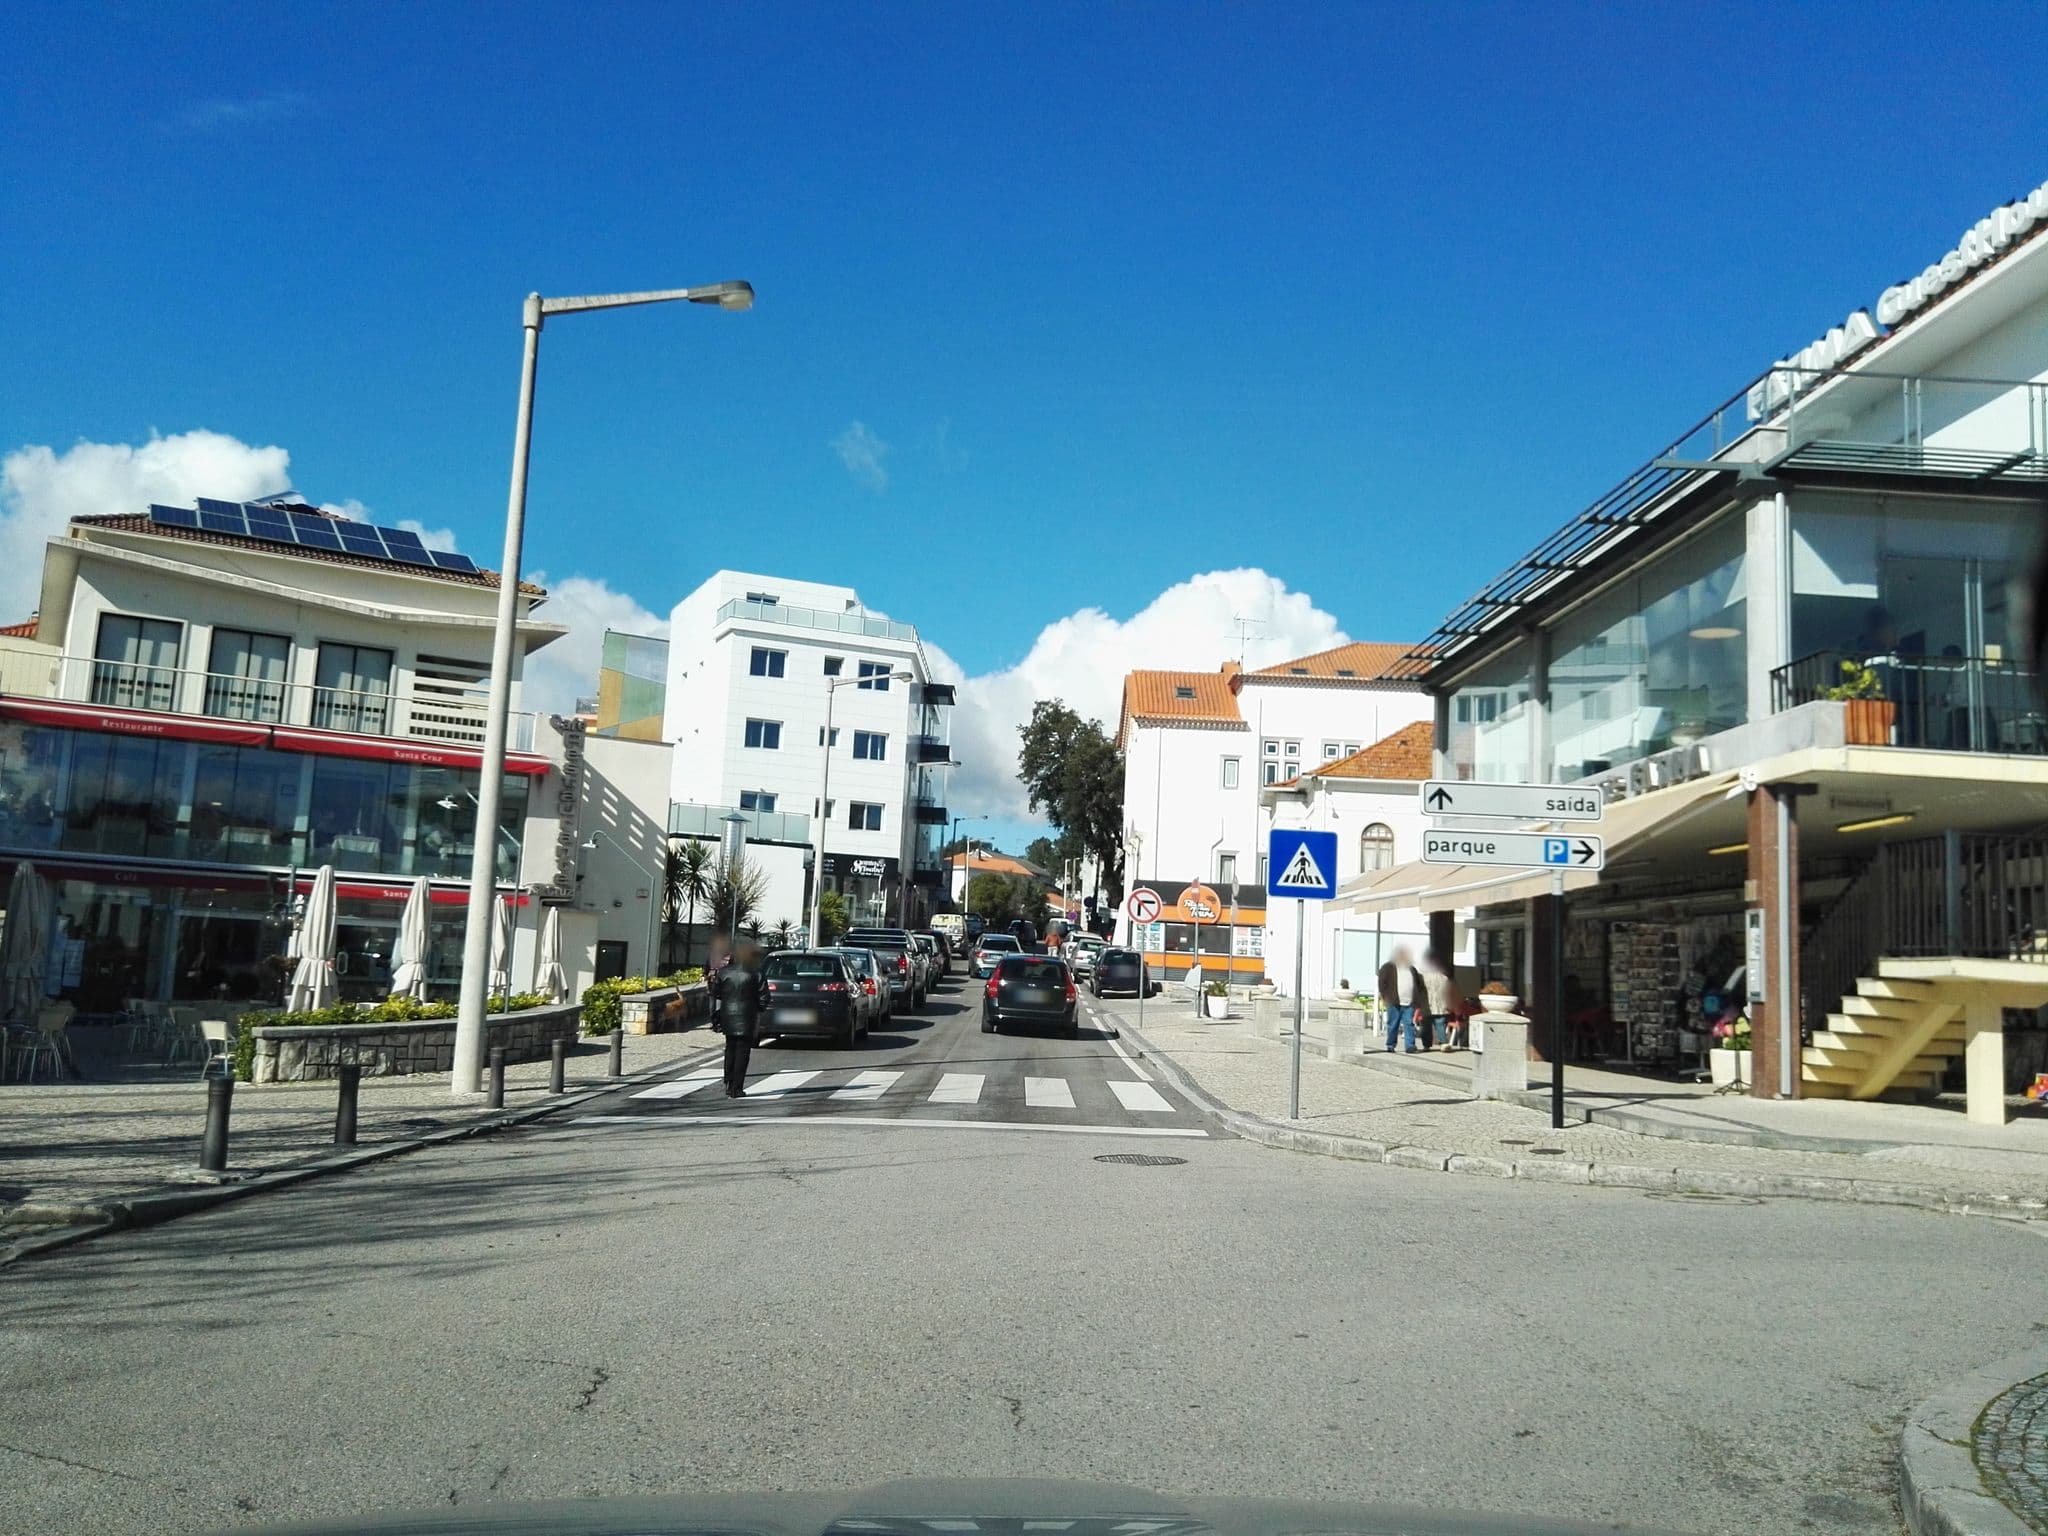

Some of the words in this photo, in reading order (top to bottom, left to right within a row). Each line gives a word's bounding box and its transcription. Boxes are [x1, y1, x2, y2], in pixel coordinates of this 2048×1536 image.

[102, 719, 164, 733] Restaurante
[394, 750, 420, 760] Santa
[421, 752, 443, 762] Cruz
[1546, 797, 1596, 812] saída
[1428, 840, 1496, 856] parque
[383, 889, 409, 900] Santa
